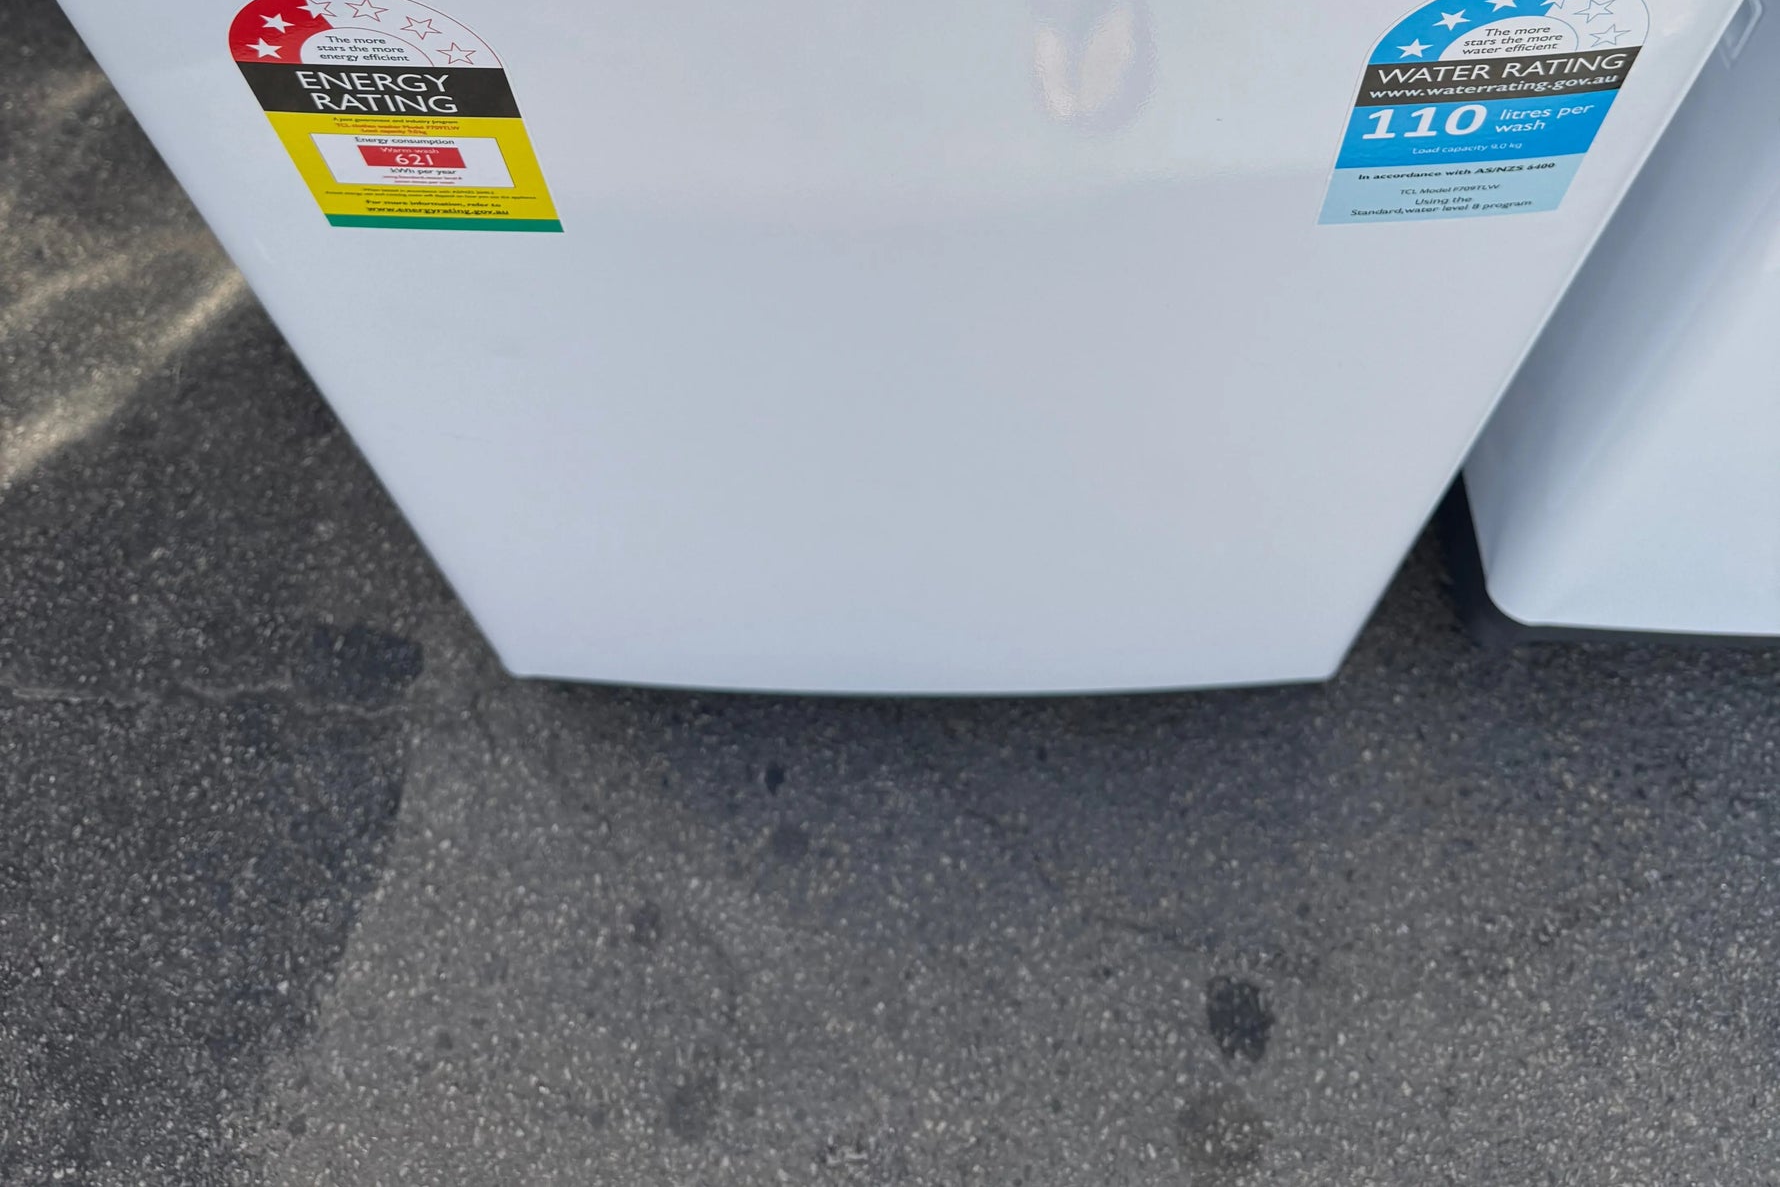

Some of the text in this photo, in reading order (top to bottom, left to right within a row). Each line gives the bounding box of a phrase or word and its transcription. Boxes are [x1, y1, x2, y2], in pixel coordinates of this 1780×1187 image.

[1486, 26, 1550, 36] The more
[325, 36, 350, 44] The
[1464, 34, 1563, 46] stars the more
[316, 44, 346, 52] stars
[349, 45, 369, 53] the
[1462, 43, 1558, 55] water efficient
[320, 54, 410, 62] energy efficient
[1378, 54, 1628, 84] WATER RATING
[296, 70, 449, 92] ENERGY
[1370, 74, 1619, 99] www.waterrating.gov.au
[310, 92, 459, 113] RATING
[1500, 104, 1594, 120] litres per
[1362, 104, 1487, 140] 110
[1495, 119, 1546, 133] wash
[1412, 147, 1440, 155] Load
[1442, 144, 1488, 153] capacity
[395, 154, 434, 165] 621
[1373, 172, 1442, 180] accordance
[1474, 165, 1523, 174] AS/NZS
[1527, 162, 1556, 170] 6400
[1350, 206, 1439, 216] Standard,water
[1442, 204, 1469, 212] level
[1483, 200, 1532, 210] program
[1415, 198, 1448, 206] Using
[367, 207, 509, 215] www.energyrating.gov.au
